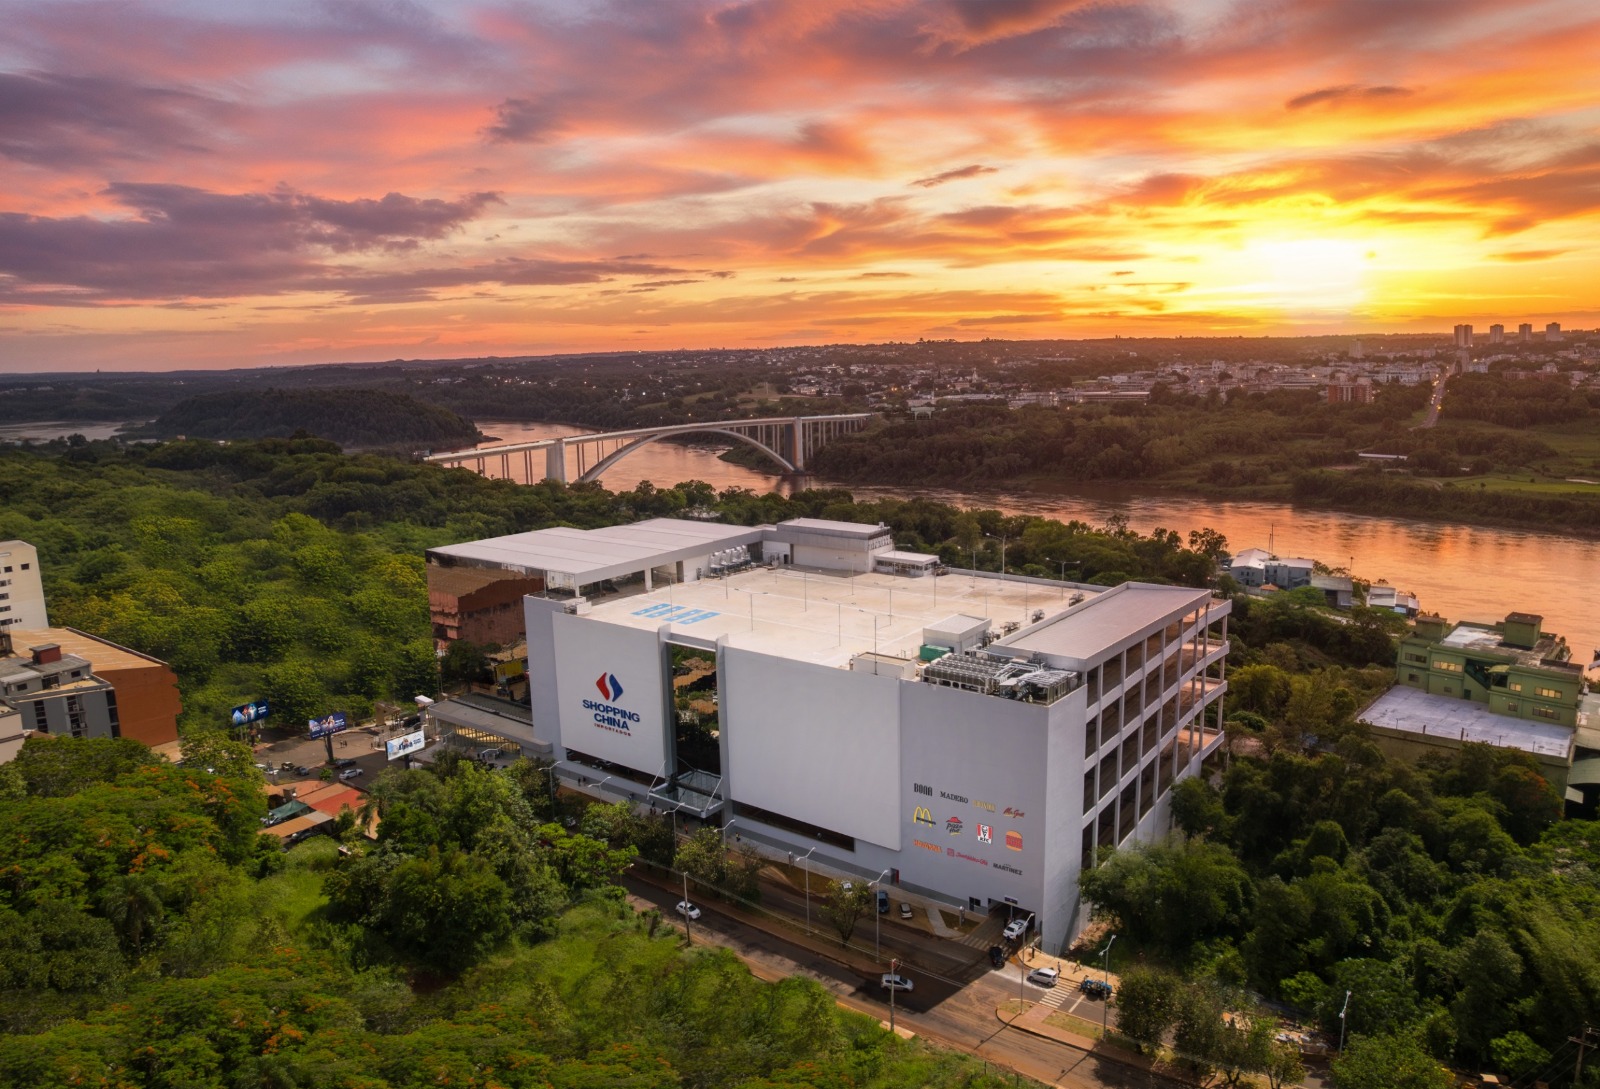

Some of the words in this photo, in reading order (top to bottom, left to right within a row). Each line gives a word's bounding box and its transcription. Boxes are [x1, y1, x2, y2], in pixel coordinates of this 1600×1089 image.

[582, 699, 640, 723] SHOPPING
[594, 713, 630, 731] CHINA
[594, 723, 631, 737] IMPORTADOS
[940, 791, 969, 804] MADERO
[993, 863, 1023, 876] MARTINEZ
